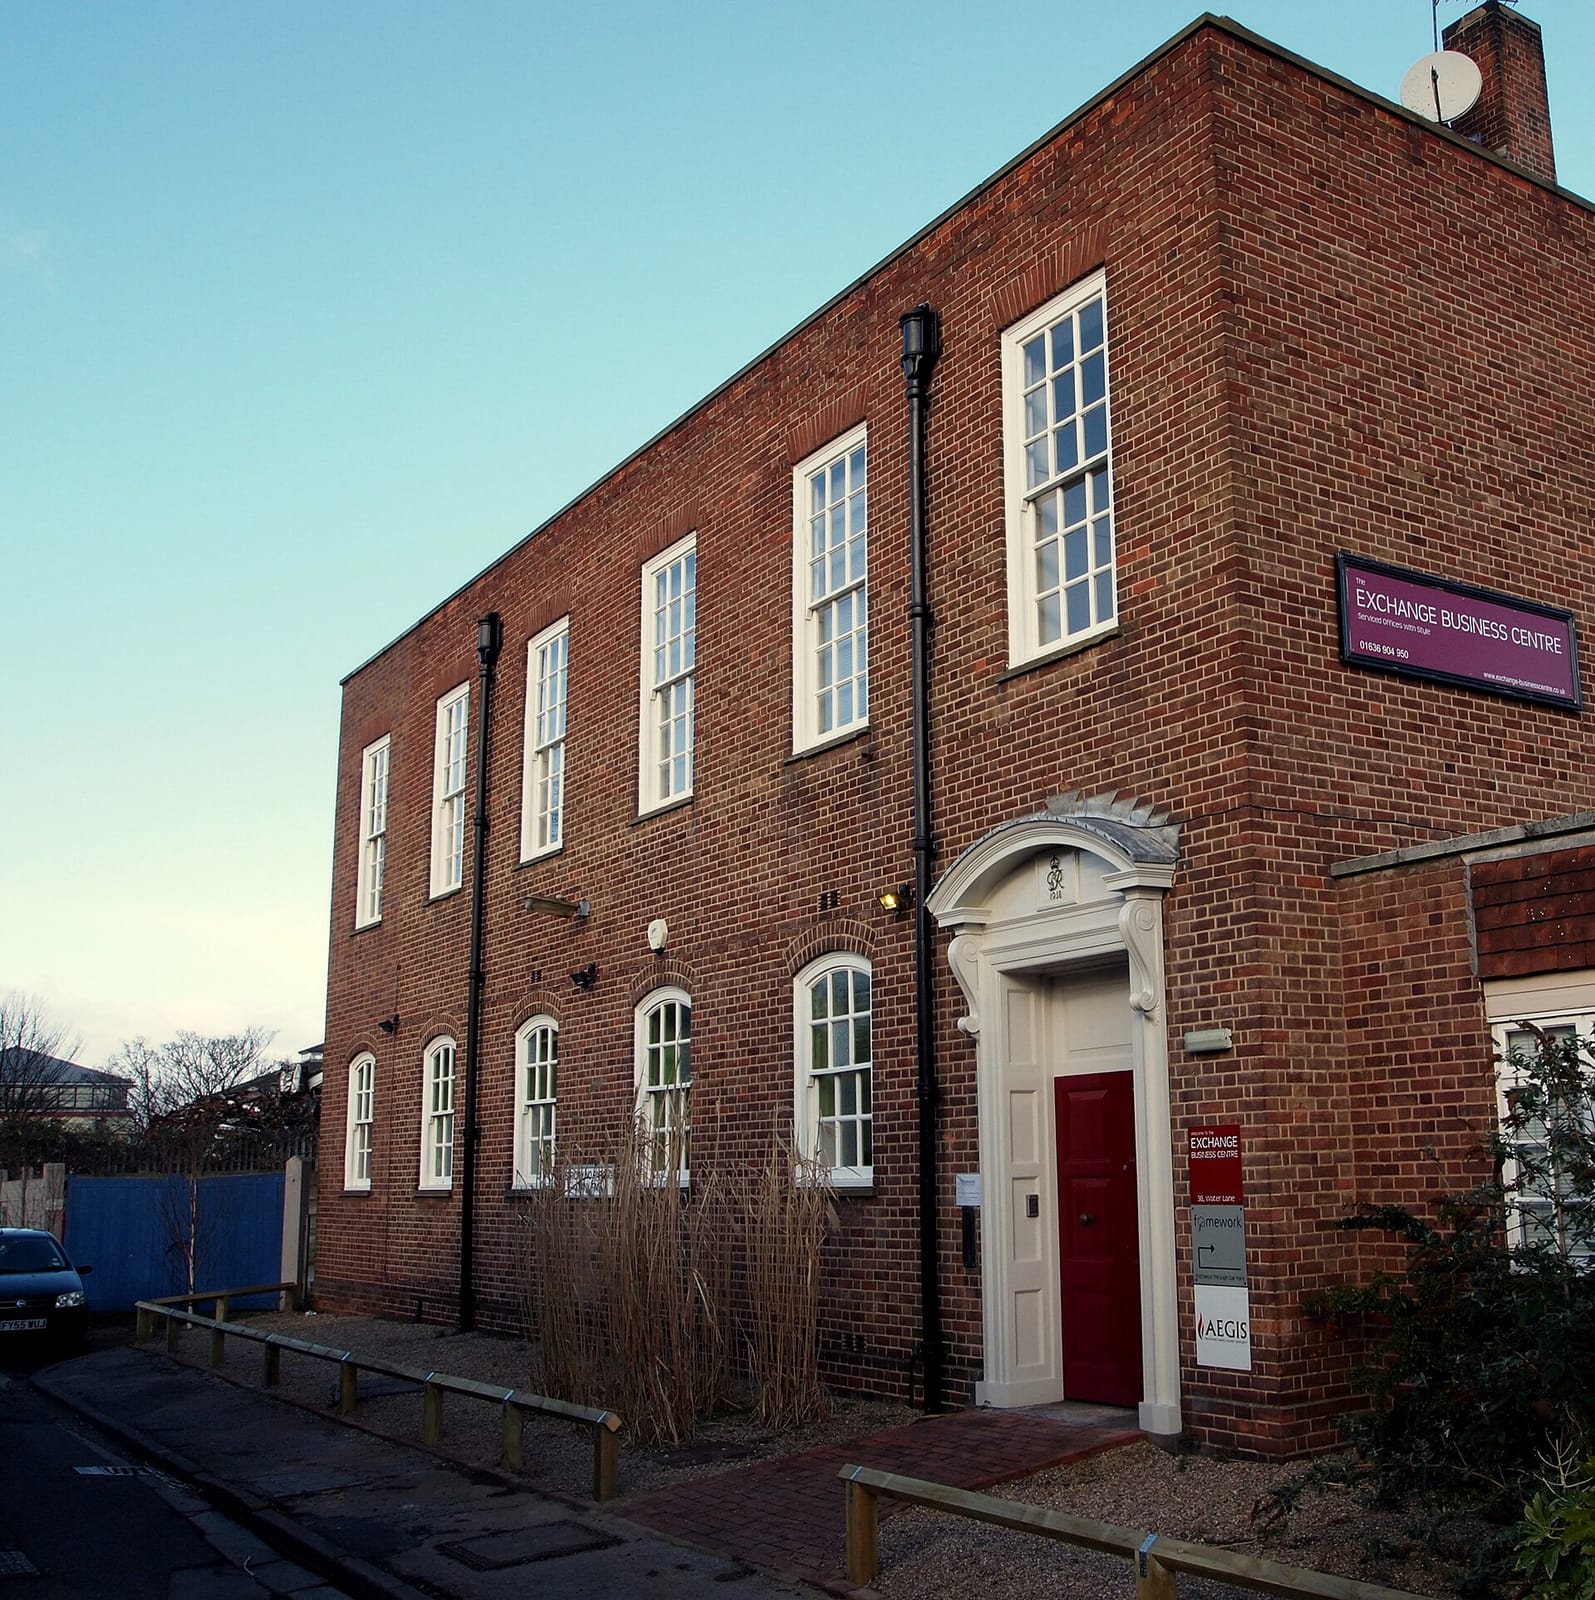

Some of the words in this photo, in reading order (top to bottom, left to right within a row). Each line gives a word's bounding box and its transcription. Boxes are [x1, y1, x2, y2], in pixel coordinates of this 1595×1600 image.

[1356, 588, 1438, 625] EXCHANGE
[1441, 609, 1508, 641] BUSINESS
[1511, 627, 1562, 654] CENTRE
[1359, 640, 1381, 653] 01636
[1382, 645, 1395, 656] 904
[1396, 648, 1409, 659] 950
[1190, 1136, 1238, 1149] EXCHANGE
[1190, 1151, 1217, 1159] BUSINESS
[1217, 1150, 1239, 1158] CENTRE
[1, 1320, 26, 1329] FY55
[1205, 1319, 1247, 1339] AEGIS
